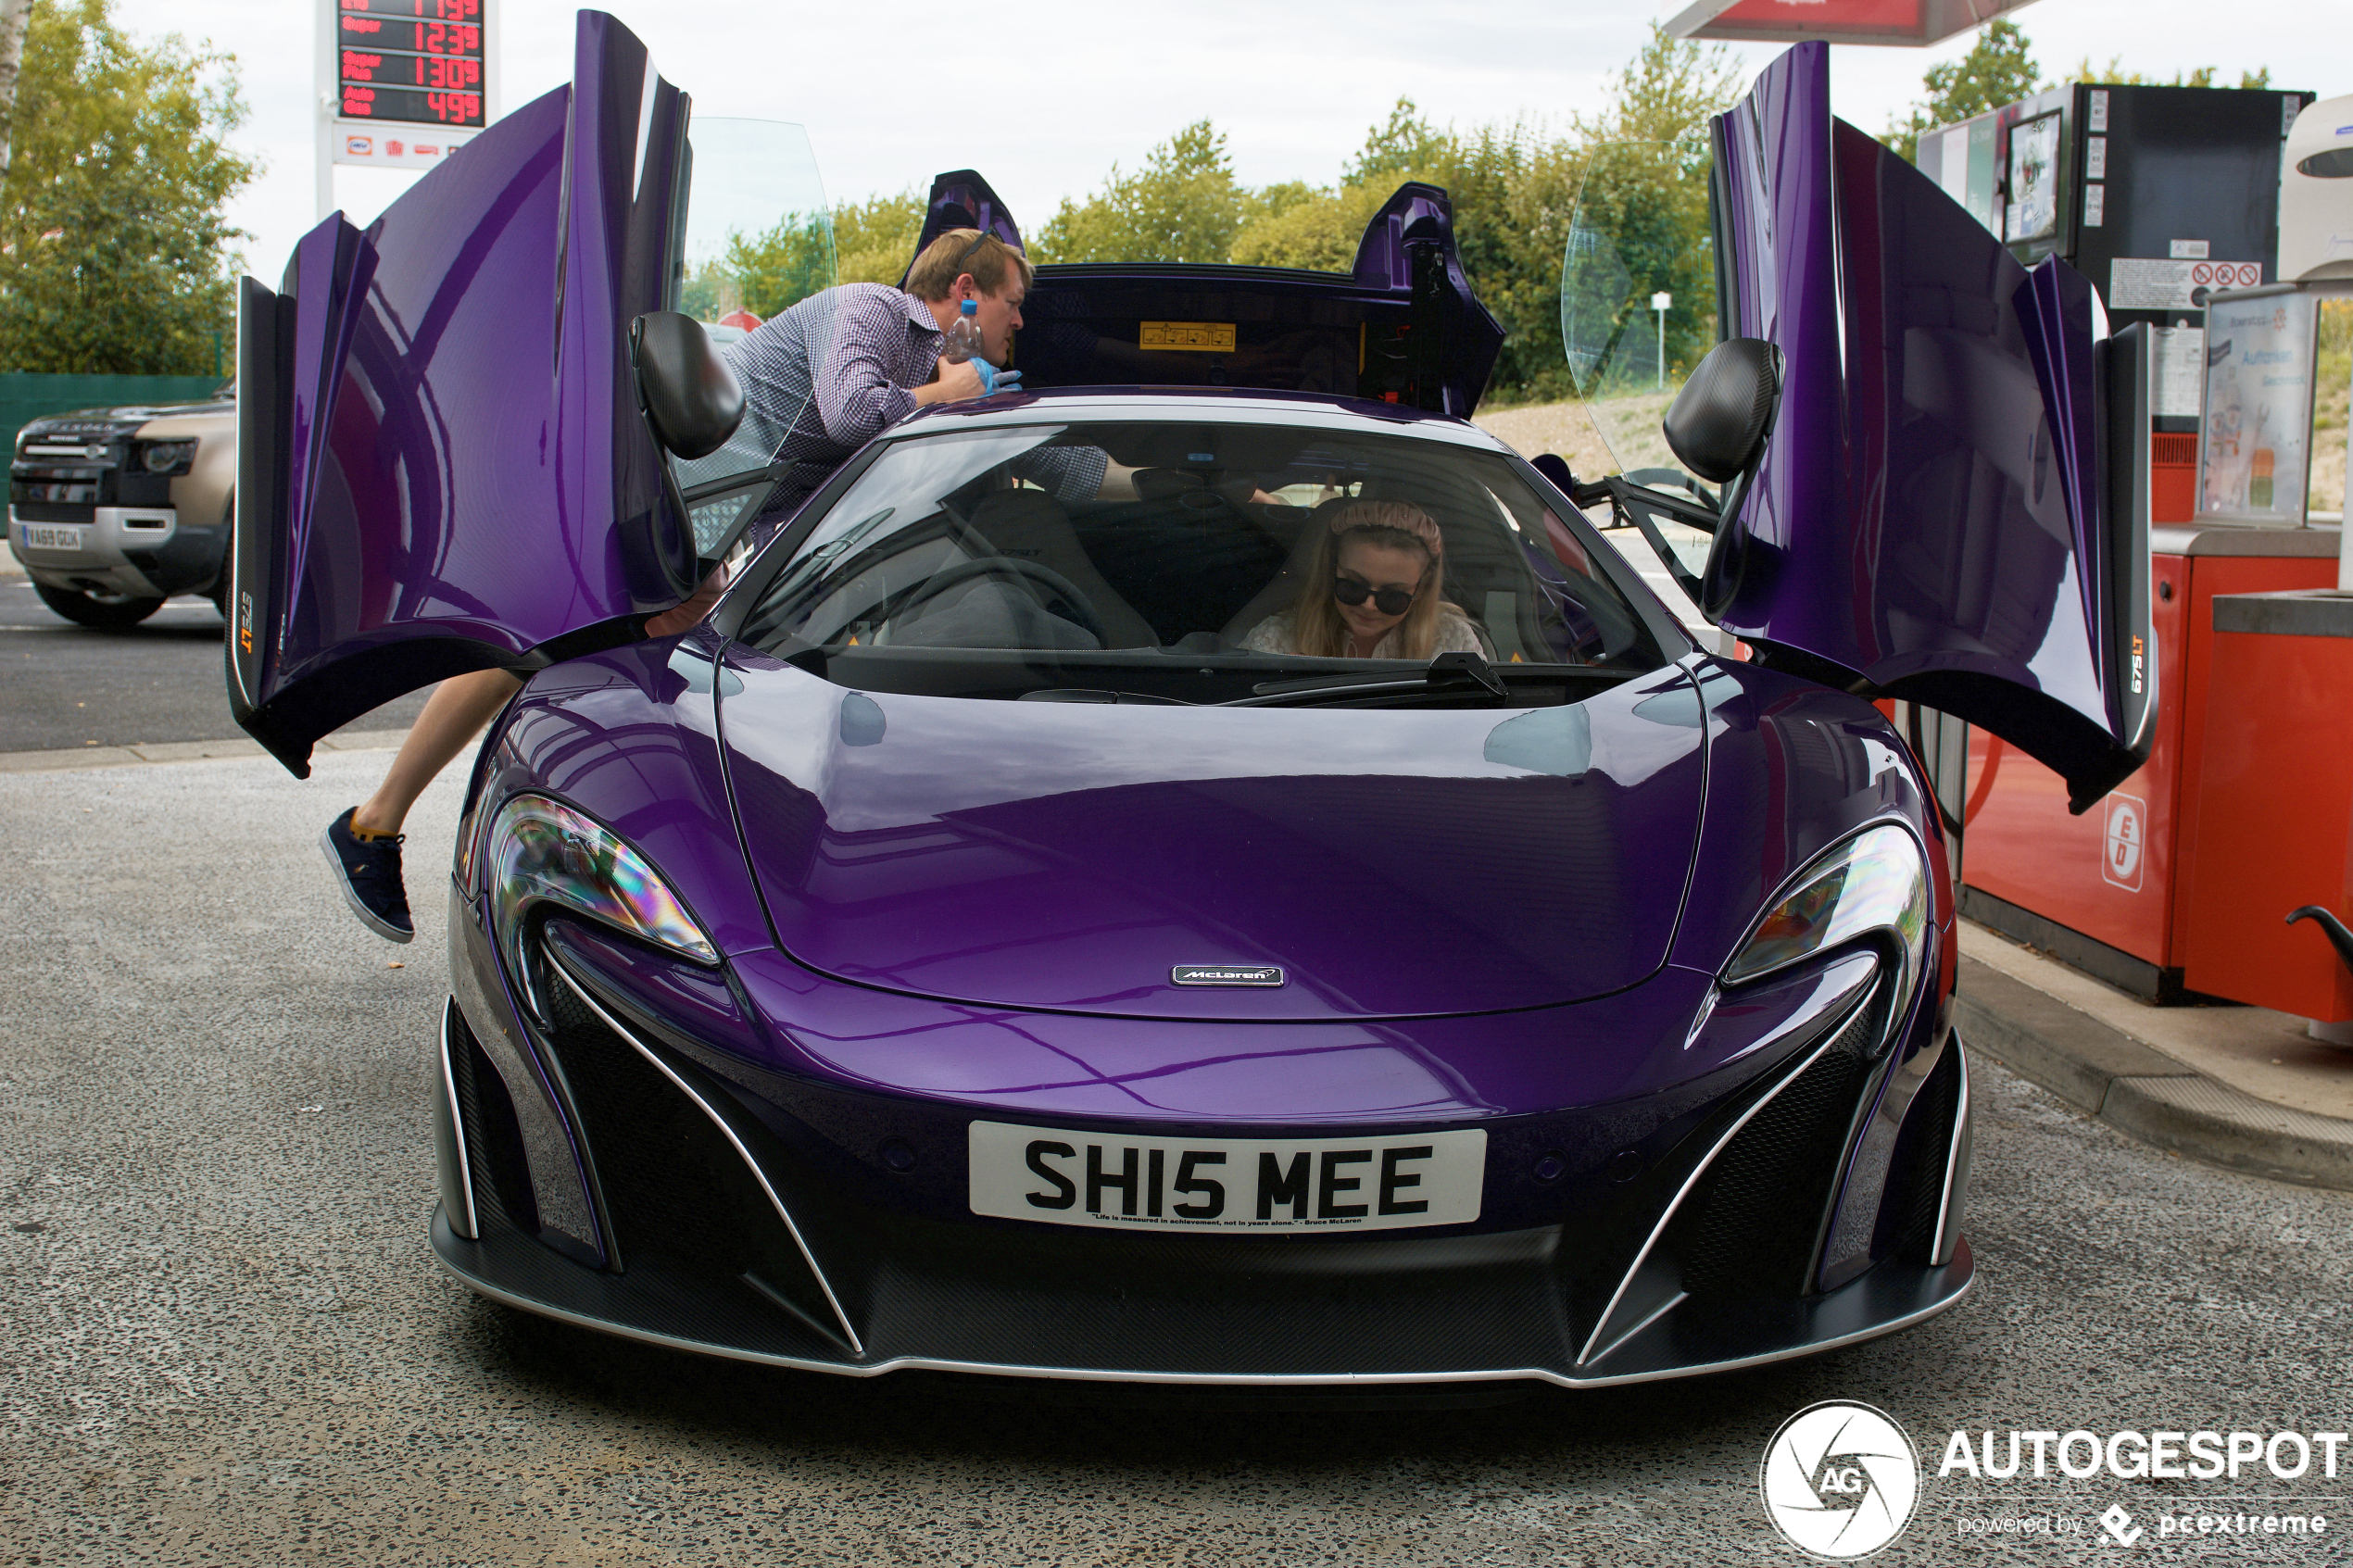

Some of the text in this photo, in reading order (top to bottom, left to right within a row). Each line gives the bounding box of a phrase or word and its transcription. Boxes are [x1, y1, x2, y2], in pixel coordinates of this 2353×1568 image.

[343, 16, 382, 33] Super
[343, 51, 382, 68] Super
[343, 64, 372, 81] Plus
[344, 85, 375, 102] Auto
[343, 100, 371, 115] Gas
[2132, 634, 2144, 694] 675LT
[1183, 971, 1266, 979] McLaren
[1255, 1145, 1434, 1221] MEE
[1170, 1218, 1222, 1226] achievement,
